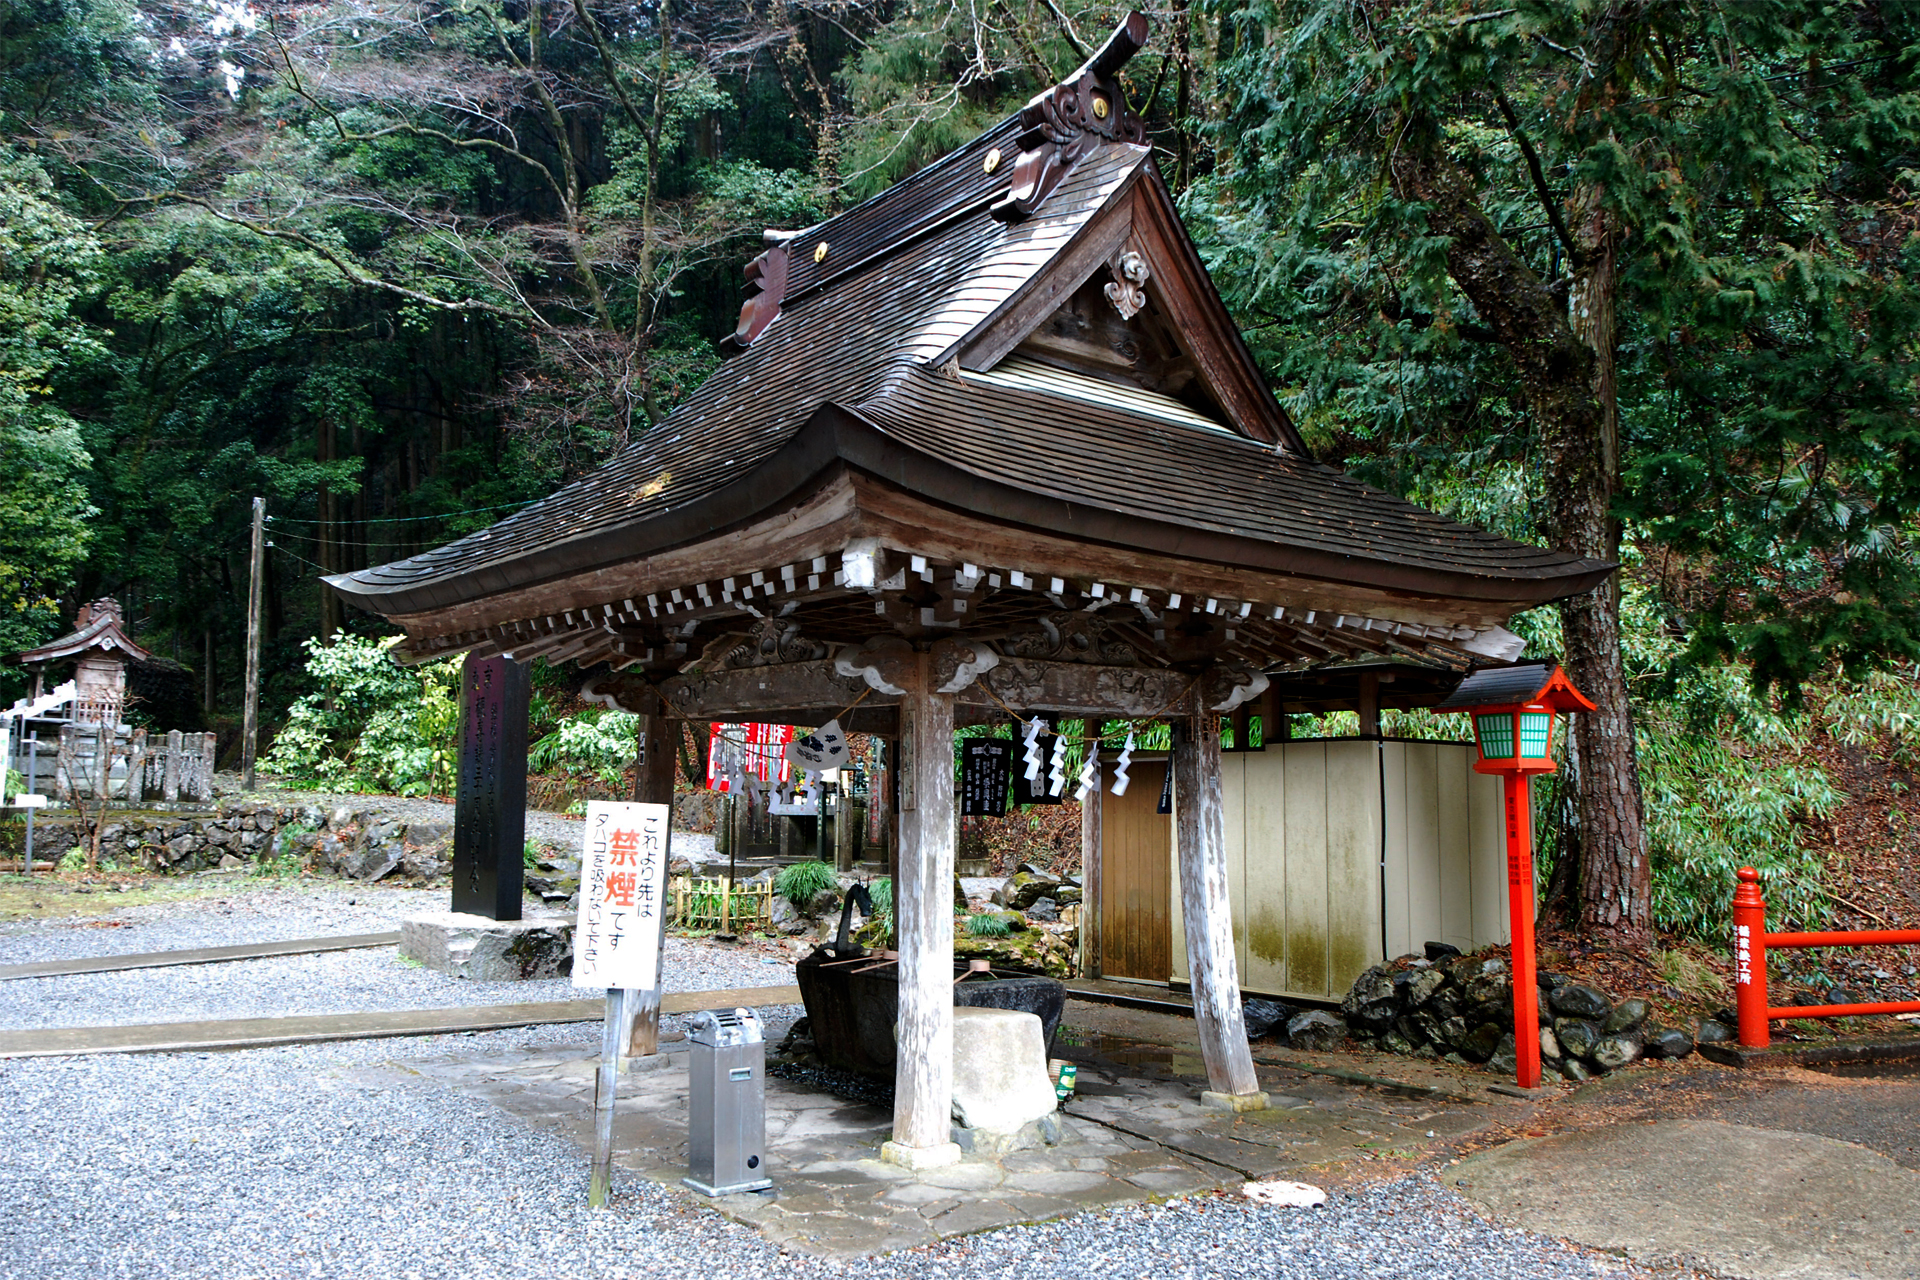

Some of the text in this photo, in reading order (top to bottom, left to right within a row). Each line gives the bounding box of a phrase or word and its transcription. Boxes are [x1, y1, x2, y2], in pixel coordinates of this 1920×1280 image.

[637, 817, 659, 918] これより先は
